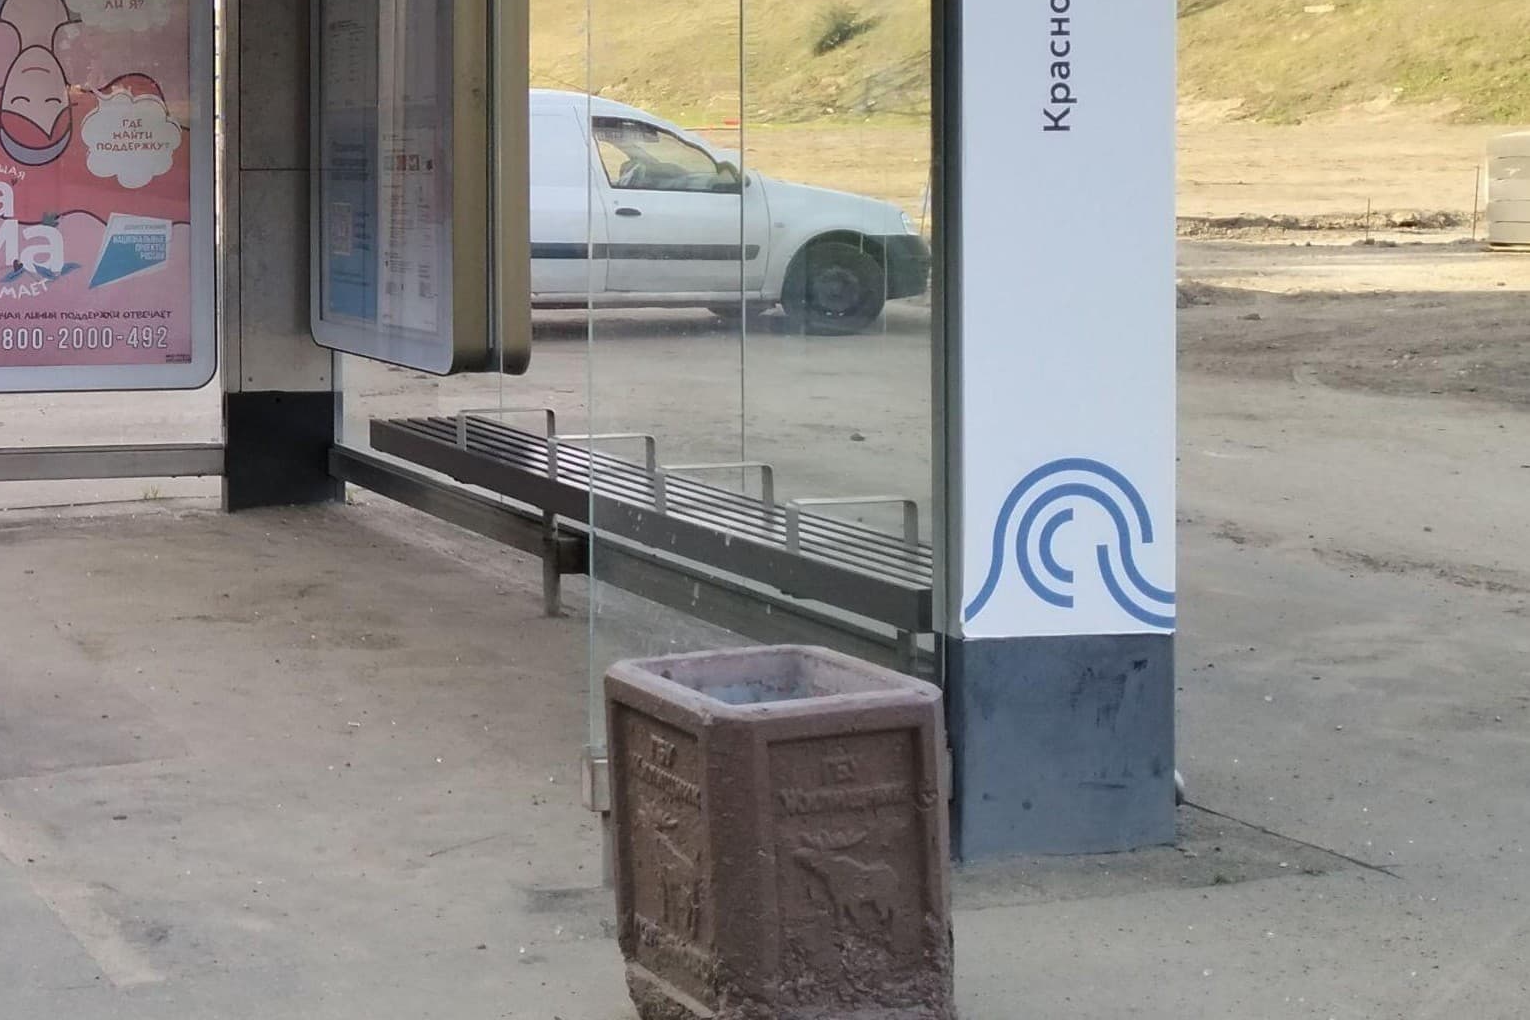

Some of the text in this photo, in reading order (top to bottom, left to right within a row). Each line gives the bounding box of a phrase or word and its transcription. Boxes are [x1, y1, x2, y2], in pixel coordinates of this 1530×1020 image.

[105, 0, 144, 10] ЛИ Я?
[122, 118, 142, 129] ГДЕ
[122, 310, 172, 319] ОТВЕЧАЕТ
